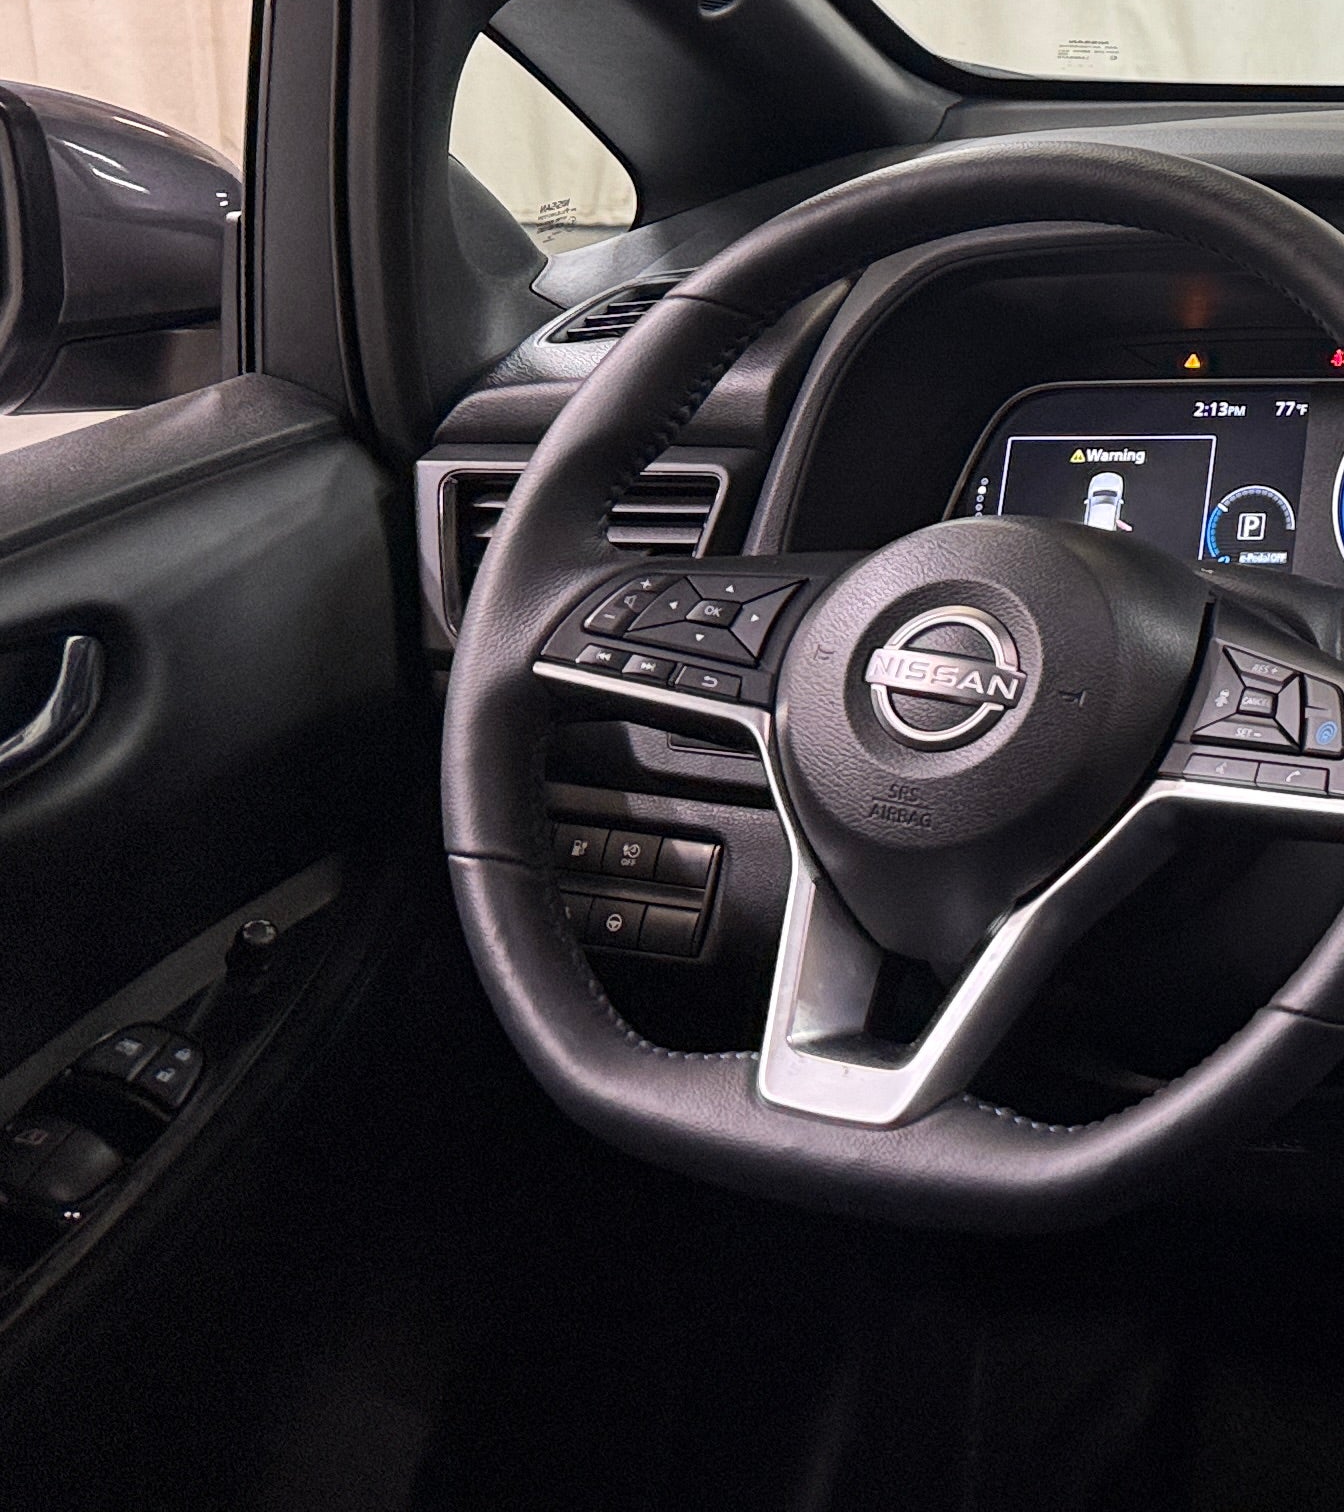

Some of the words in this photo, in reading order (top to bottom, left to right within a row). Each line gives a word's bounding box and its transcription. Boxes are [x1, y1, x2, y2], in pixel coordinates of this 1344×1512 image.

[1275, 400, 1309, 417] 77°F
[1086, 447, 1147, 465] Warning
[1243, 516, 1260, 538] P
[704, 604, 723, 618] OK
[869, 654, 1019, 700] NISSAN
[1235, 727, 1253, 738] SET
[868, 803, 932, 827] AIRBAG
